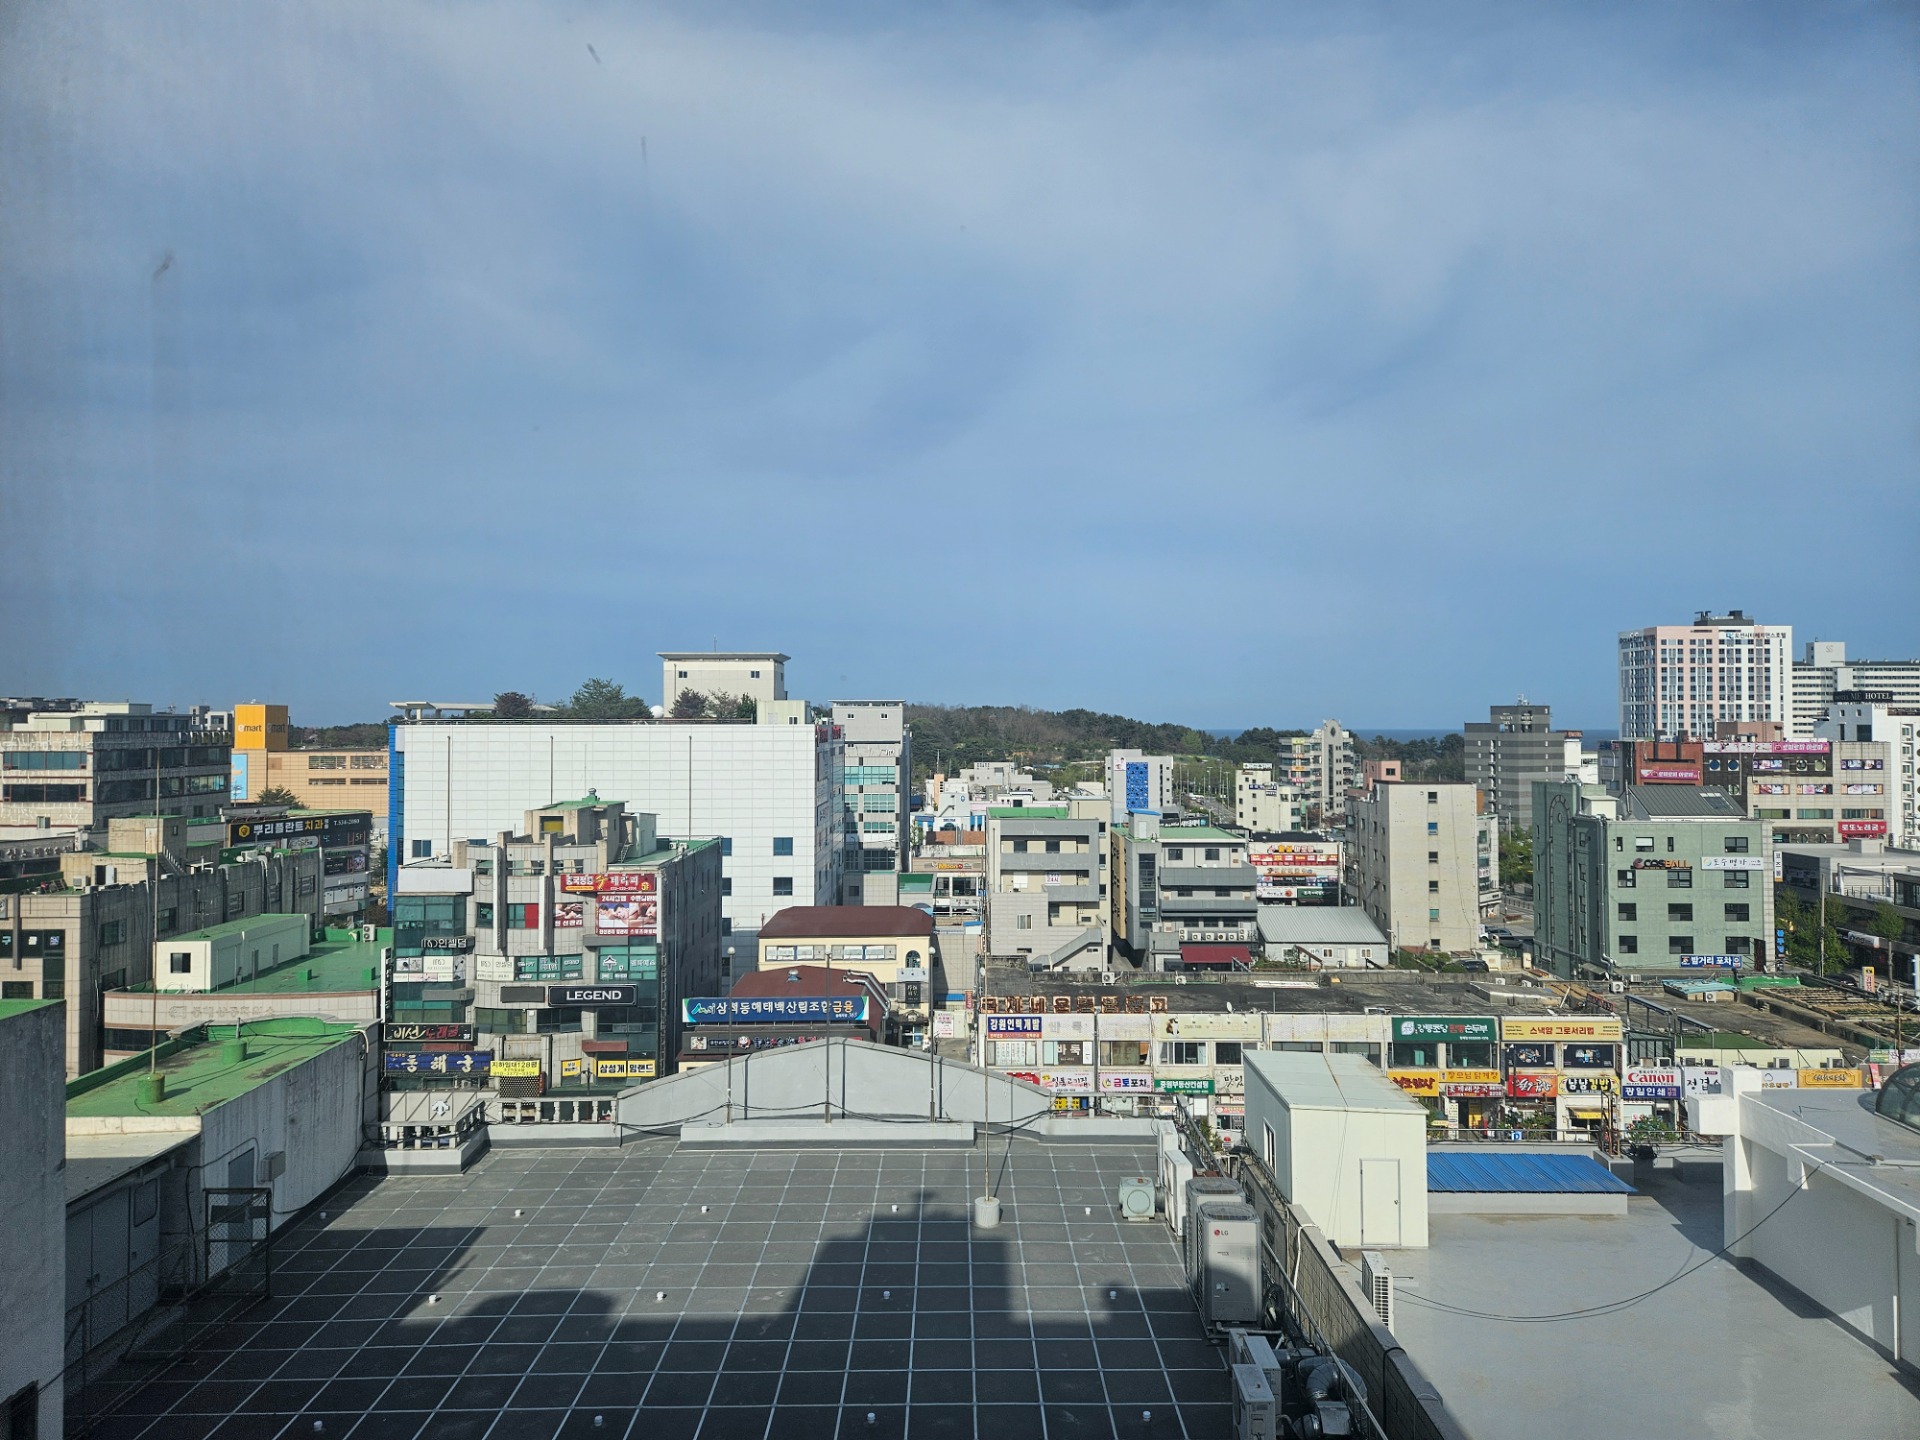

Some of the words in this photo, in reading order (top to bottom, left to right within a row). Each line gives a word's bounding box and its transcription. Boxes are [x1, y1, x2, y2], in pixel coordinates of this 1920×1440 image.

[1865, 692, 1891, 700] HOTEL
[238, 724, 262, 733] emart
[438, 938, 467, 948] 인셀덤
[566, 990, 622, 1000] LEGEND
[1628, 1072, 1675, 1083] Canon
[1625, 1087, 1666, 1096] 광일인쇄
